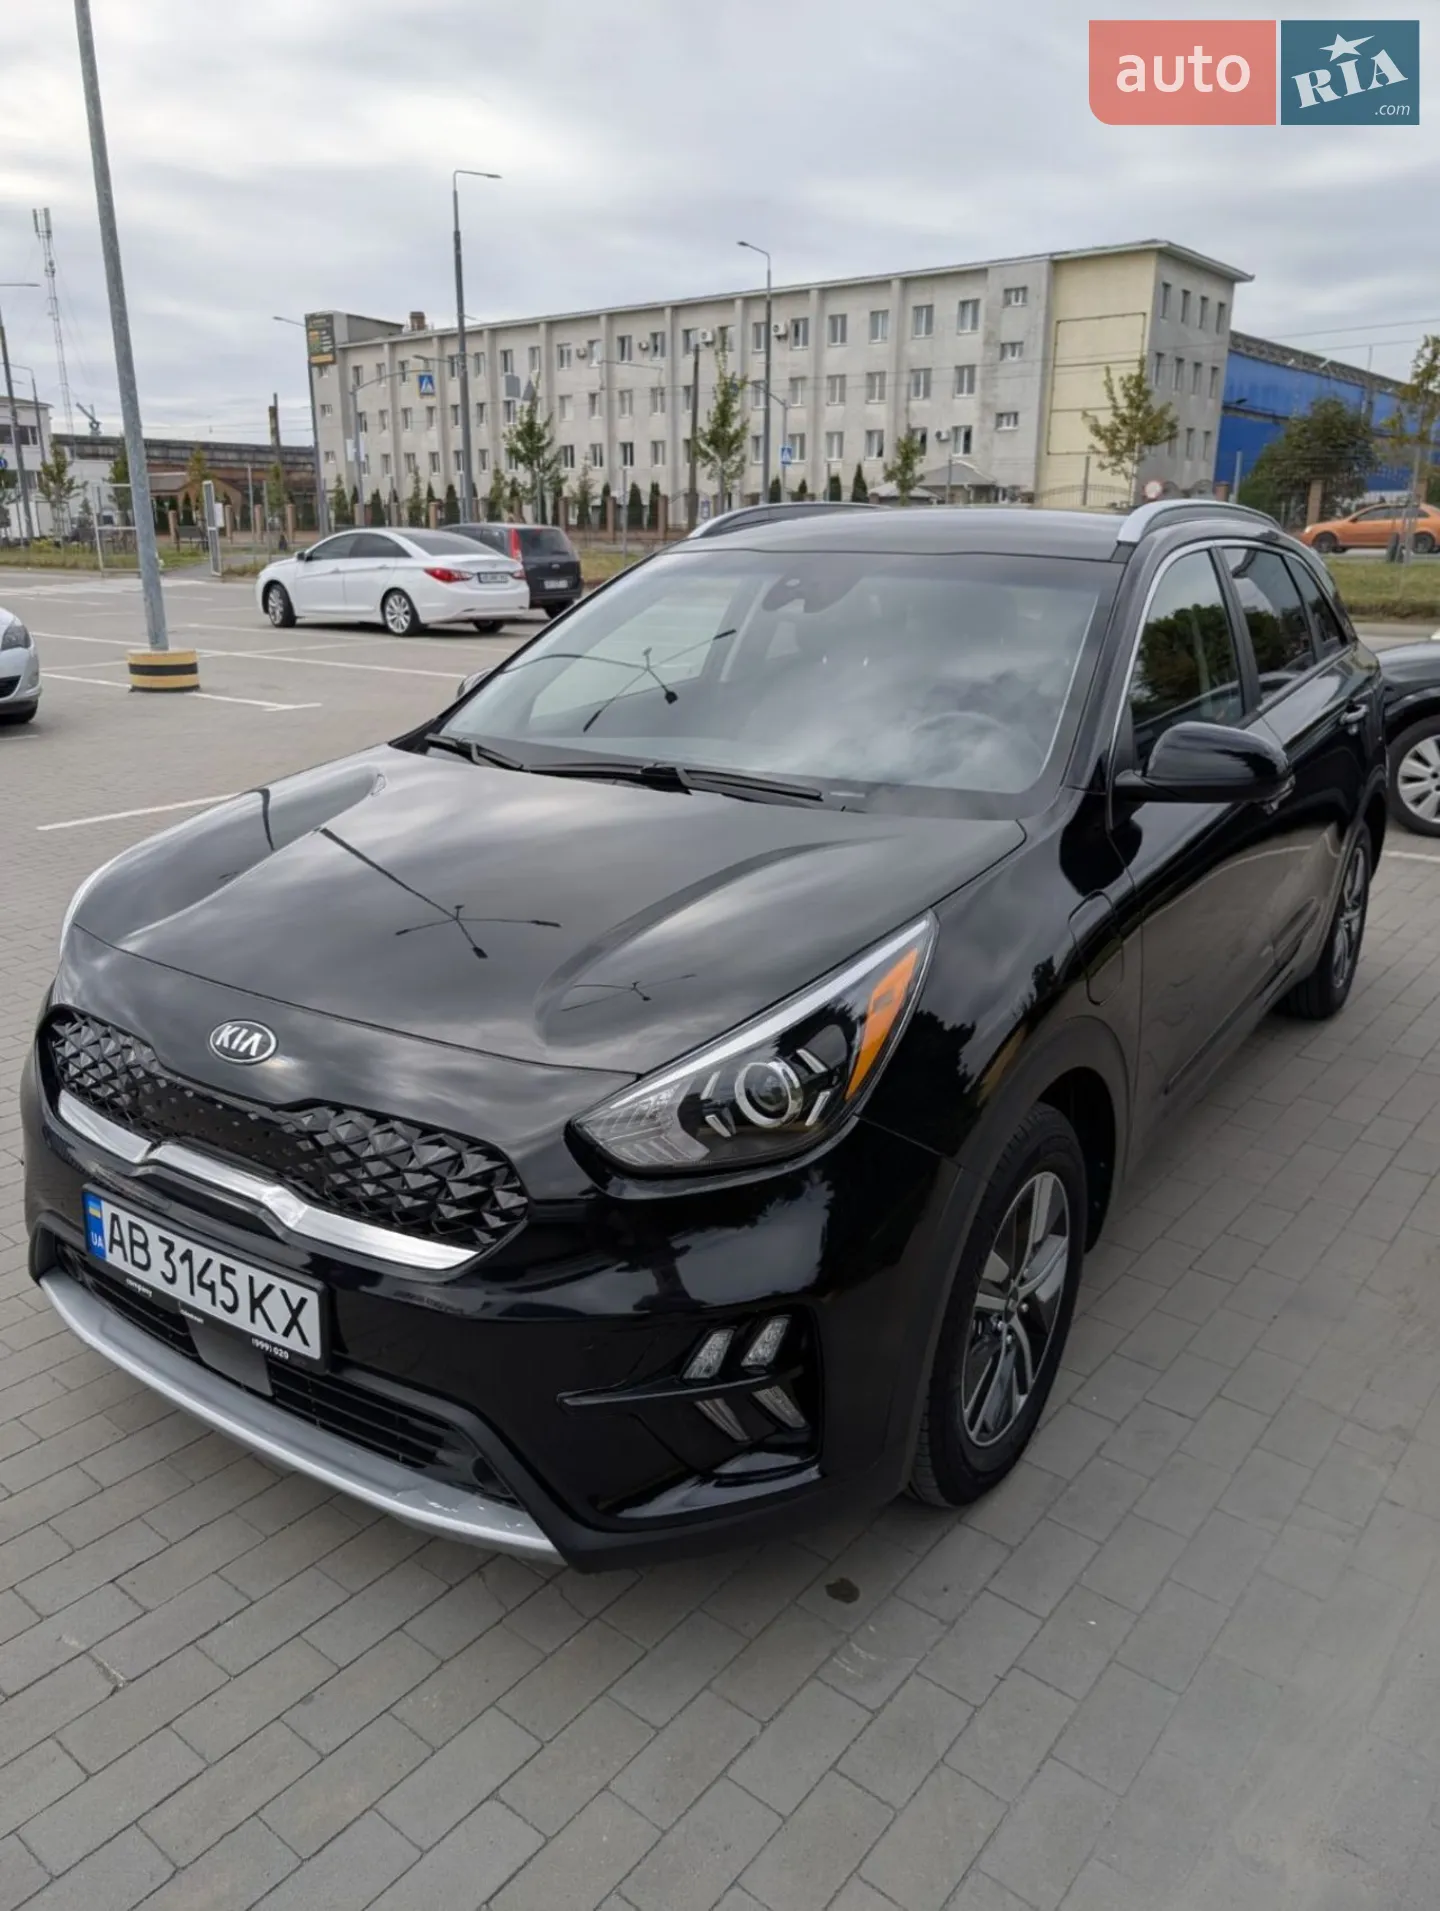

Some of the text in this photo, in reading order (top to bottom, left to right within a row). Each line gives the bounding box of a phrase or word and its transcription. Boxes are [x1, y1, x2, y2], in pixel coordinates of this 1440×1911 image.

[215, 1025, 263, 1057] KIA
[91, 1232, 104, 1248] UA
[109, 1212, 311, 1347] AB 3145 KX
